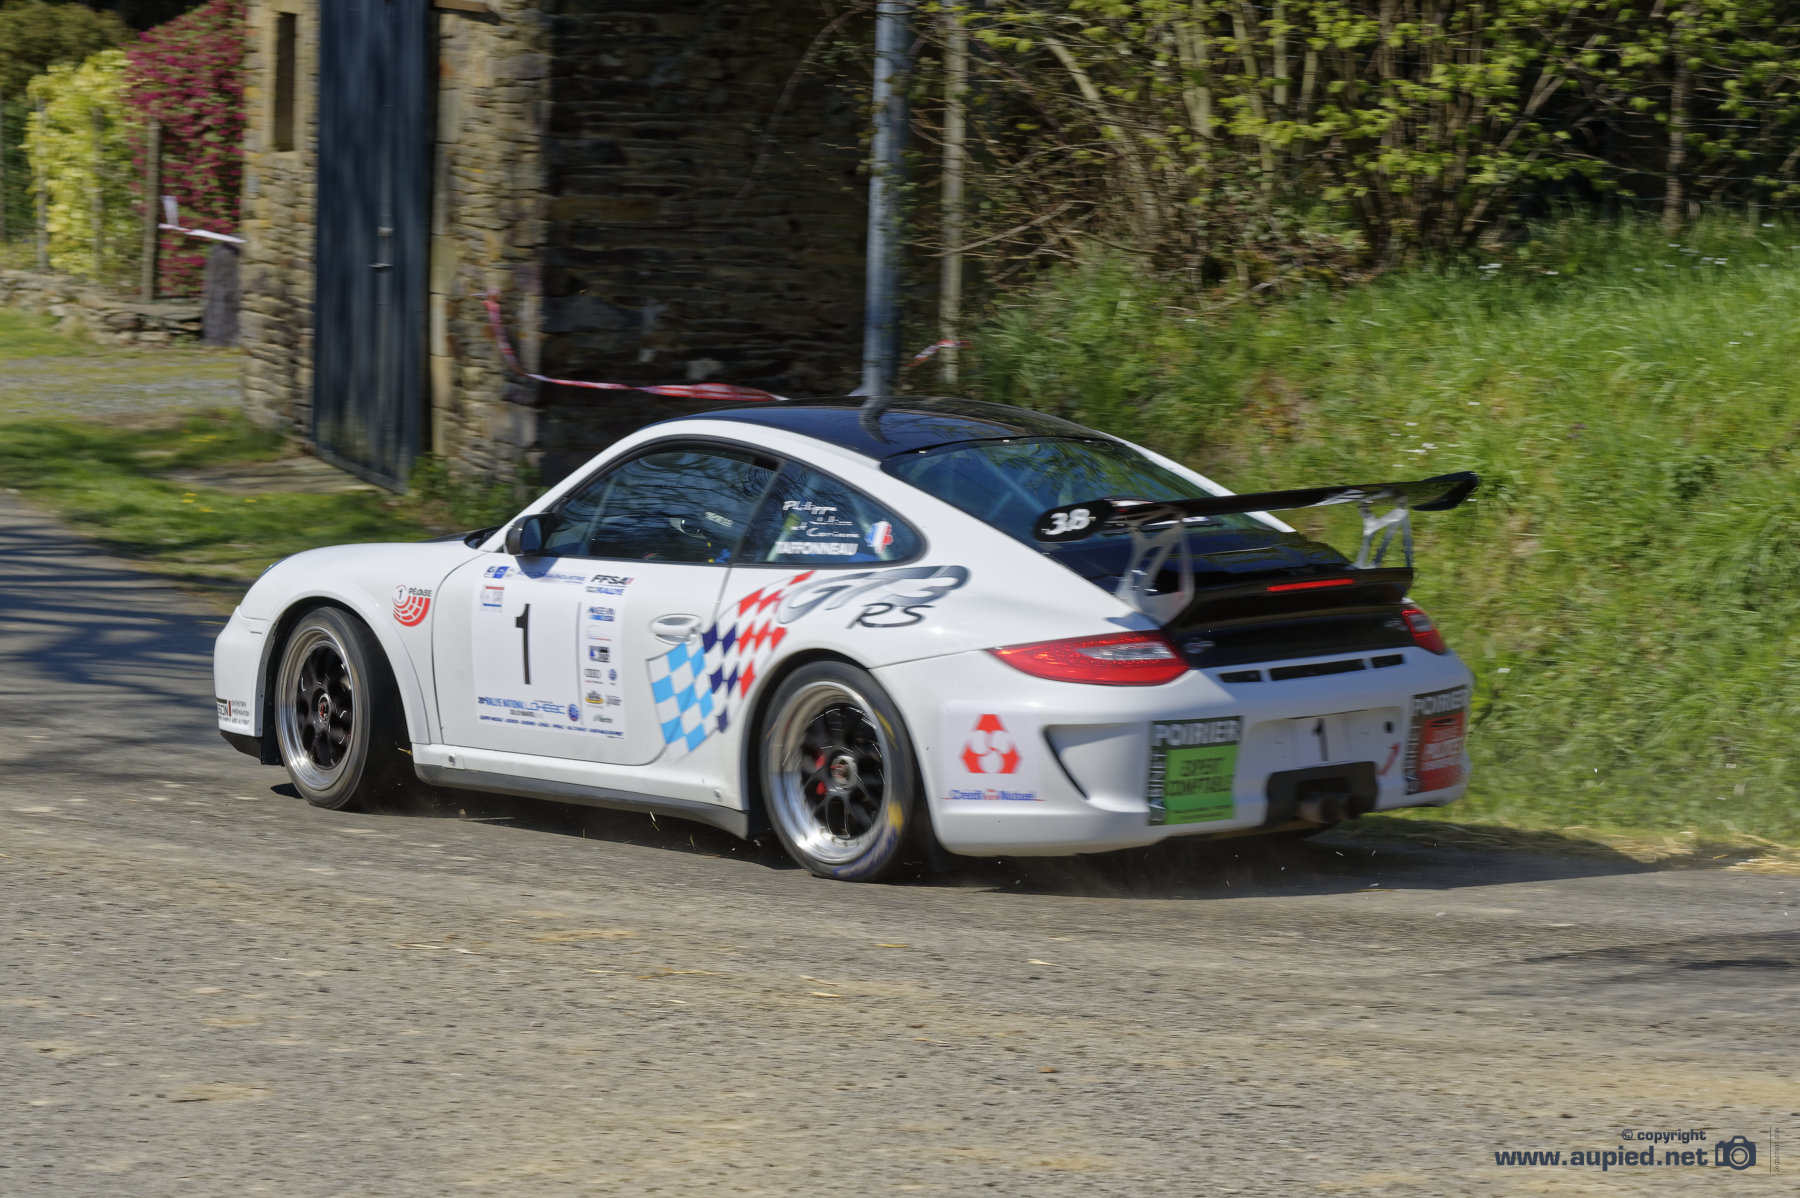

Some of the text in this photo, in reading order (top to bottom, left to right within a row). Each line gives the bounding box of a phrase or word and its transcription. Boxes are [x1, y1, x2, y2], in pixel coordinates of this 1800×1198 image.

[845, 602, 936, 629] RS
[515, 603, 531, 685] 1
[1152, 719, 1241, 747] POIRIER
